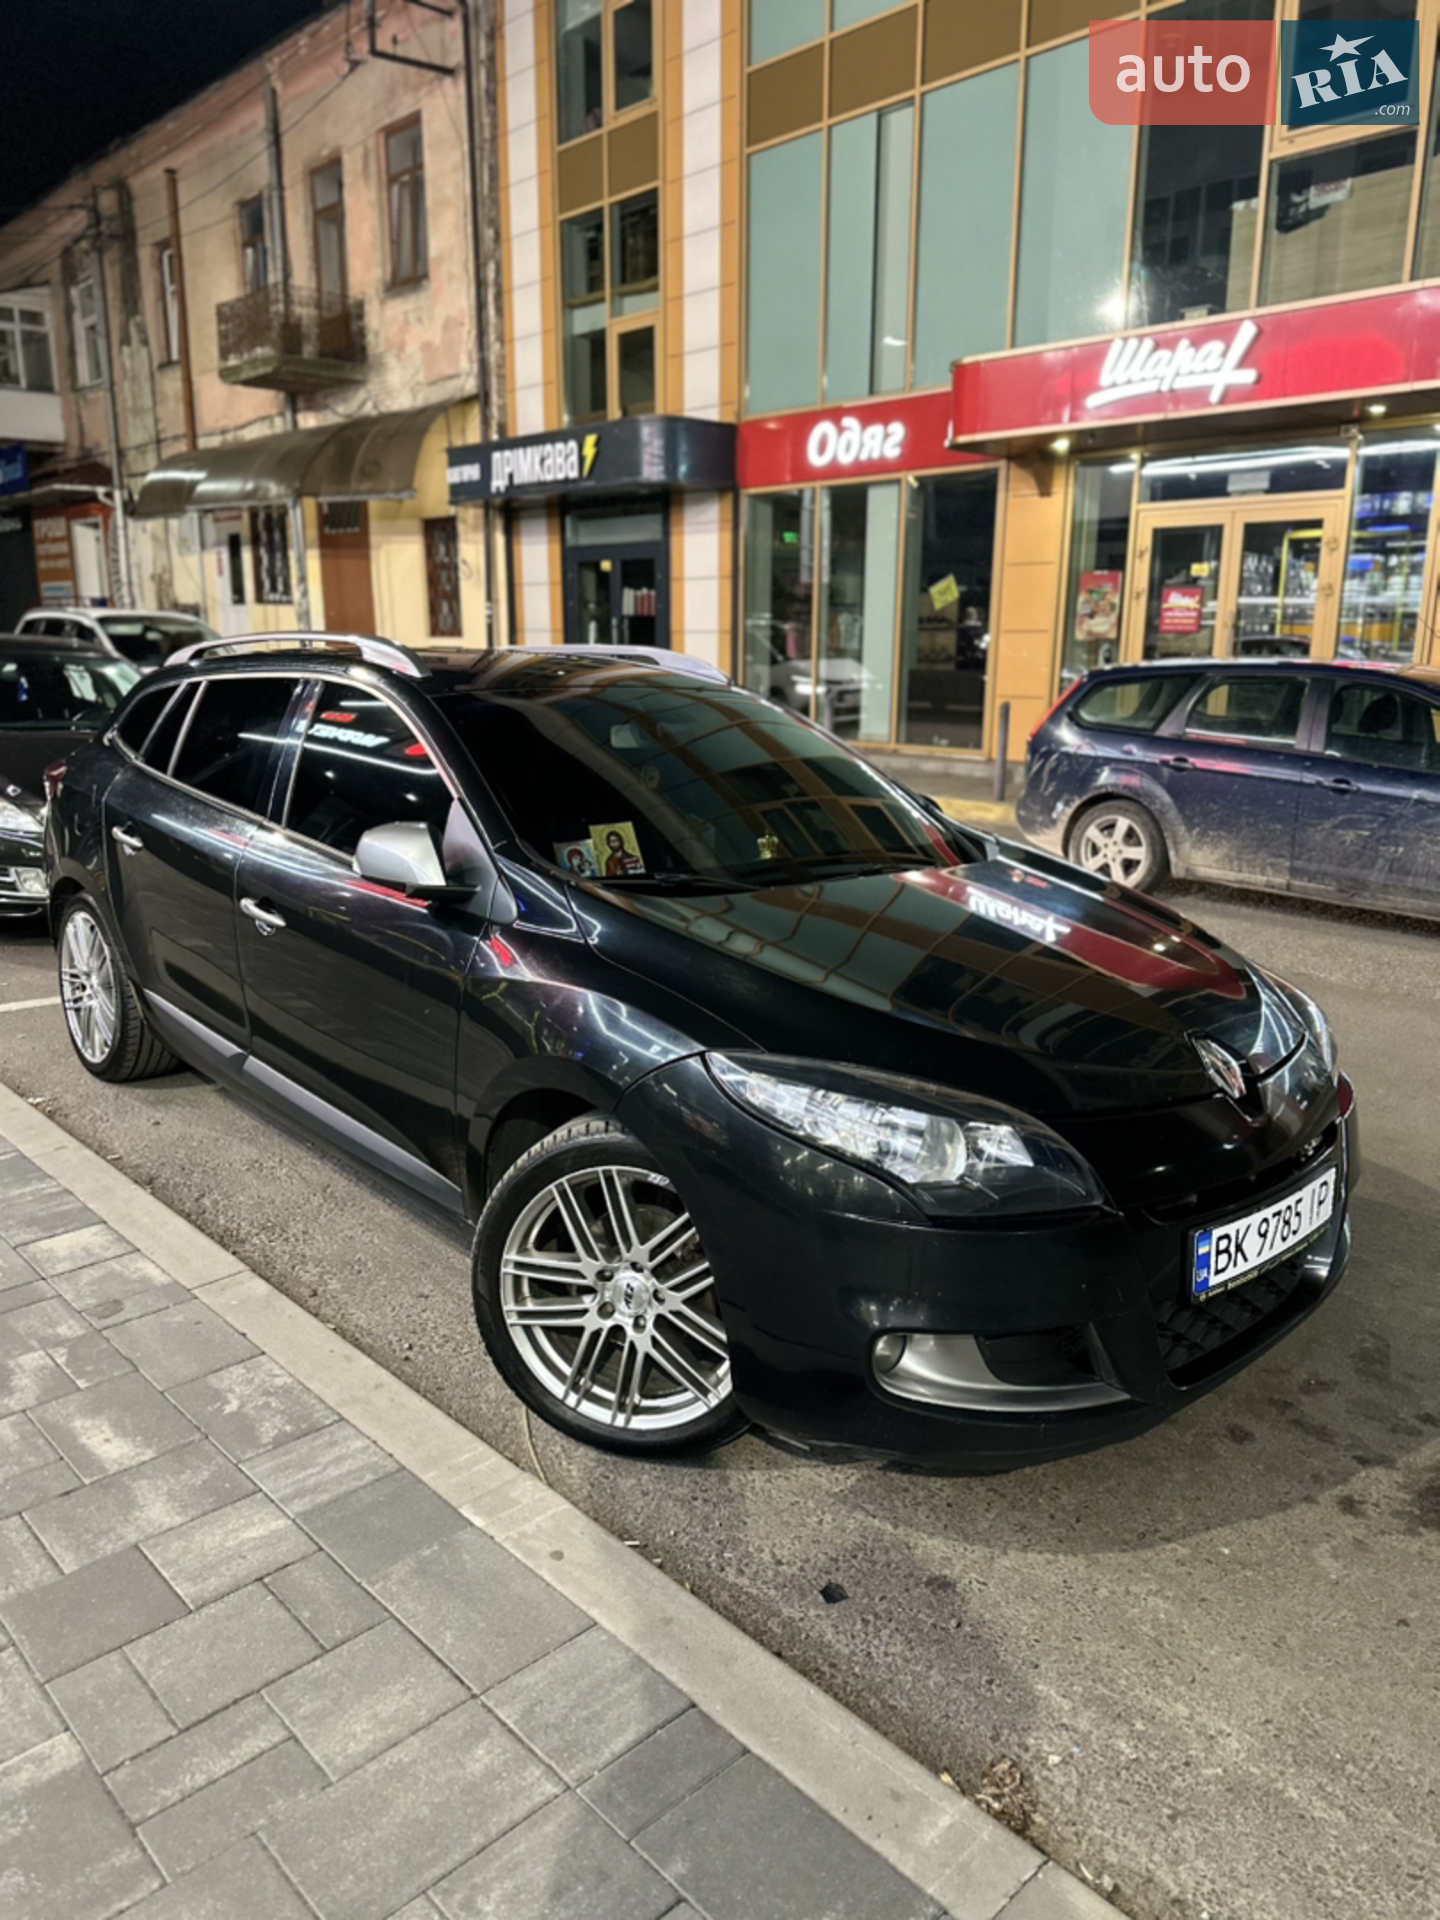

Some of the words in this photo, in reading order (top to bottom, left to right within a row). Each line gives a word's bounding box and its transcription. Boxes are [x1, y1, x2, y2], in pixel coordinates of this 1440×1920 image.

[806, 416, 905, 467] Одяг
[1214, 1223, 1251, 1276] BK
[1257, 1197, 1303, 1257] 9785
[1308, 1180, 1330, 1226] IP
